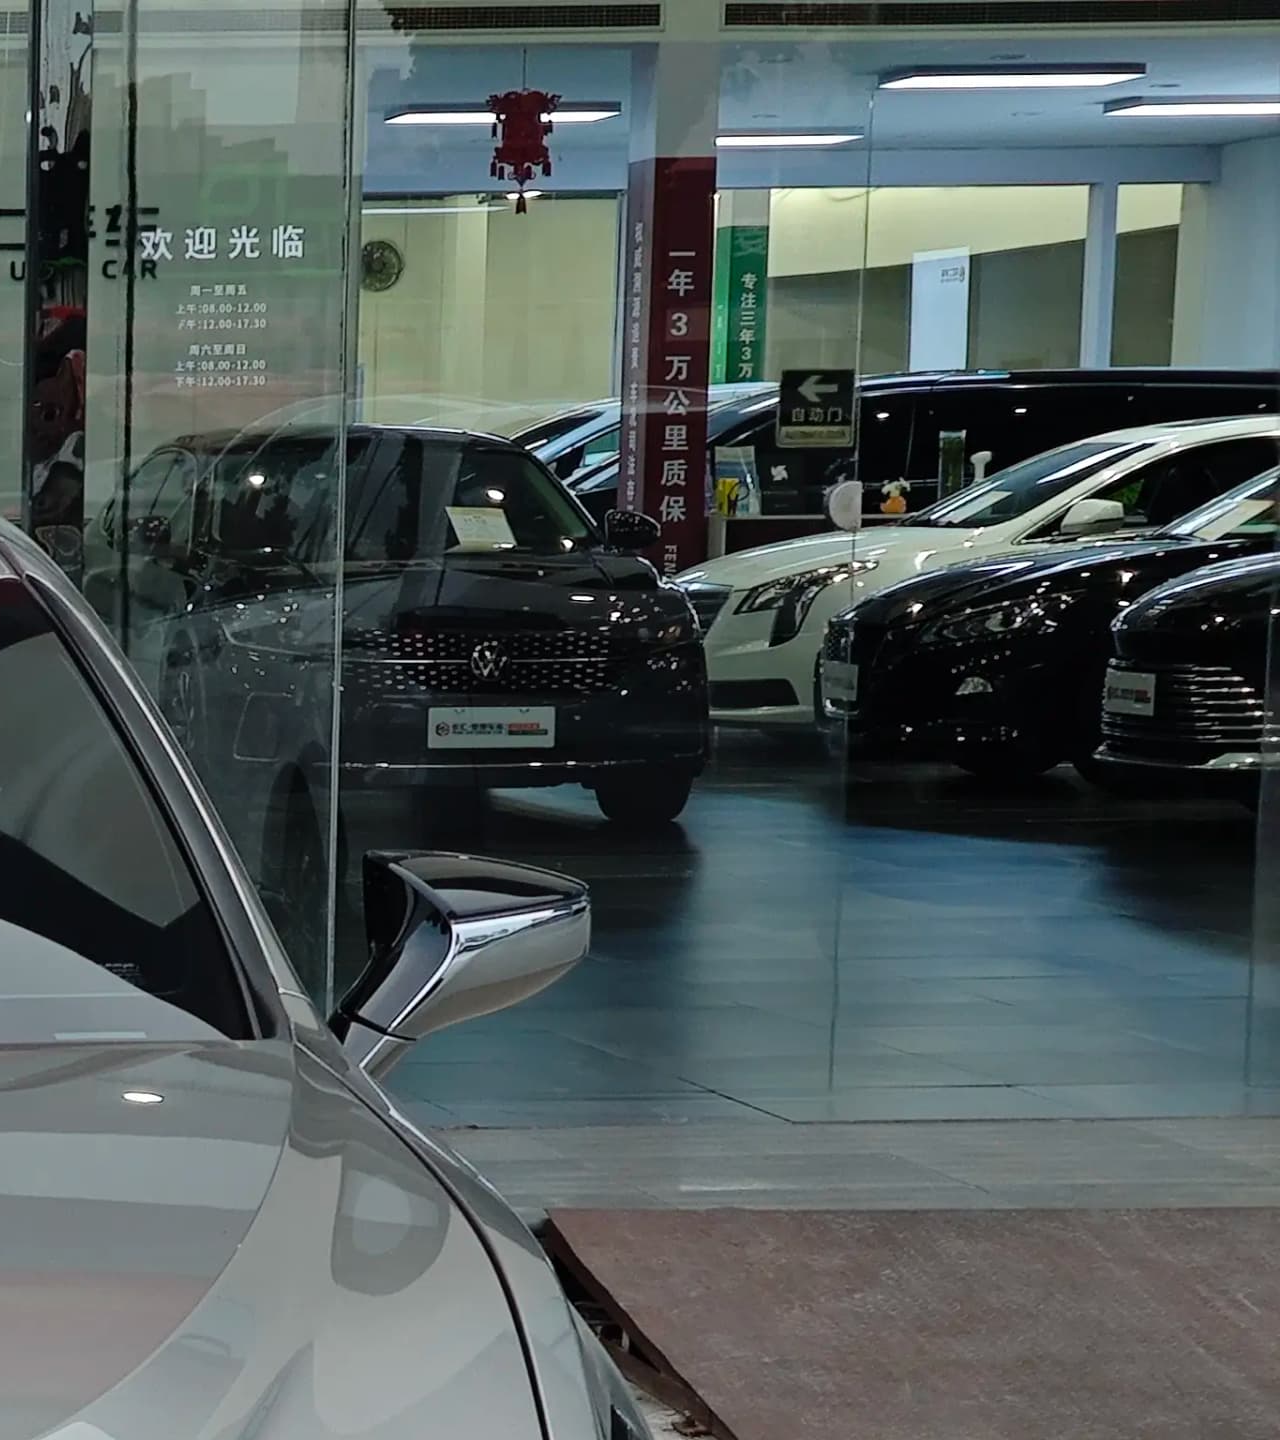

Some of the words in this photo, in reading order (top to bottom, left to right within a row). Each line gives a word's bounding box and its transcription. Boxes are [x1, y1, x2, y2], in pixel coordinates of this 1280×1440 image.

[140, 225, 304, 260] 欢迎光临
[738, 272, 758, 378] 专注三年3万
[659, 251, 696, 523] 一年3万公里质保
[791, 407, 843, 424] 自动门
[664, 544, 678, 580] FEN
